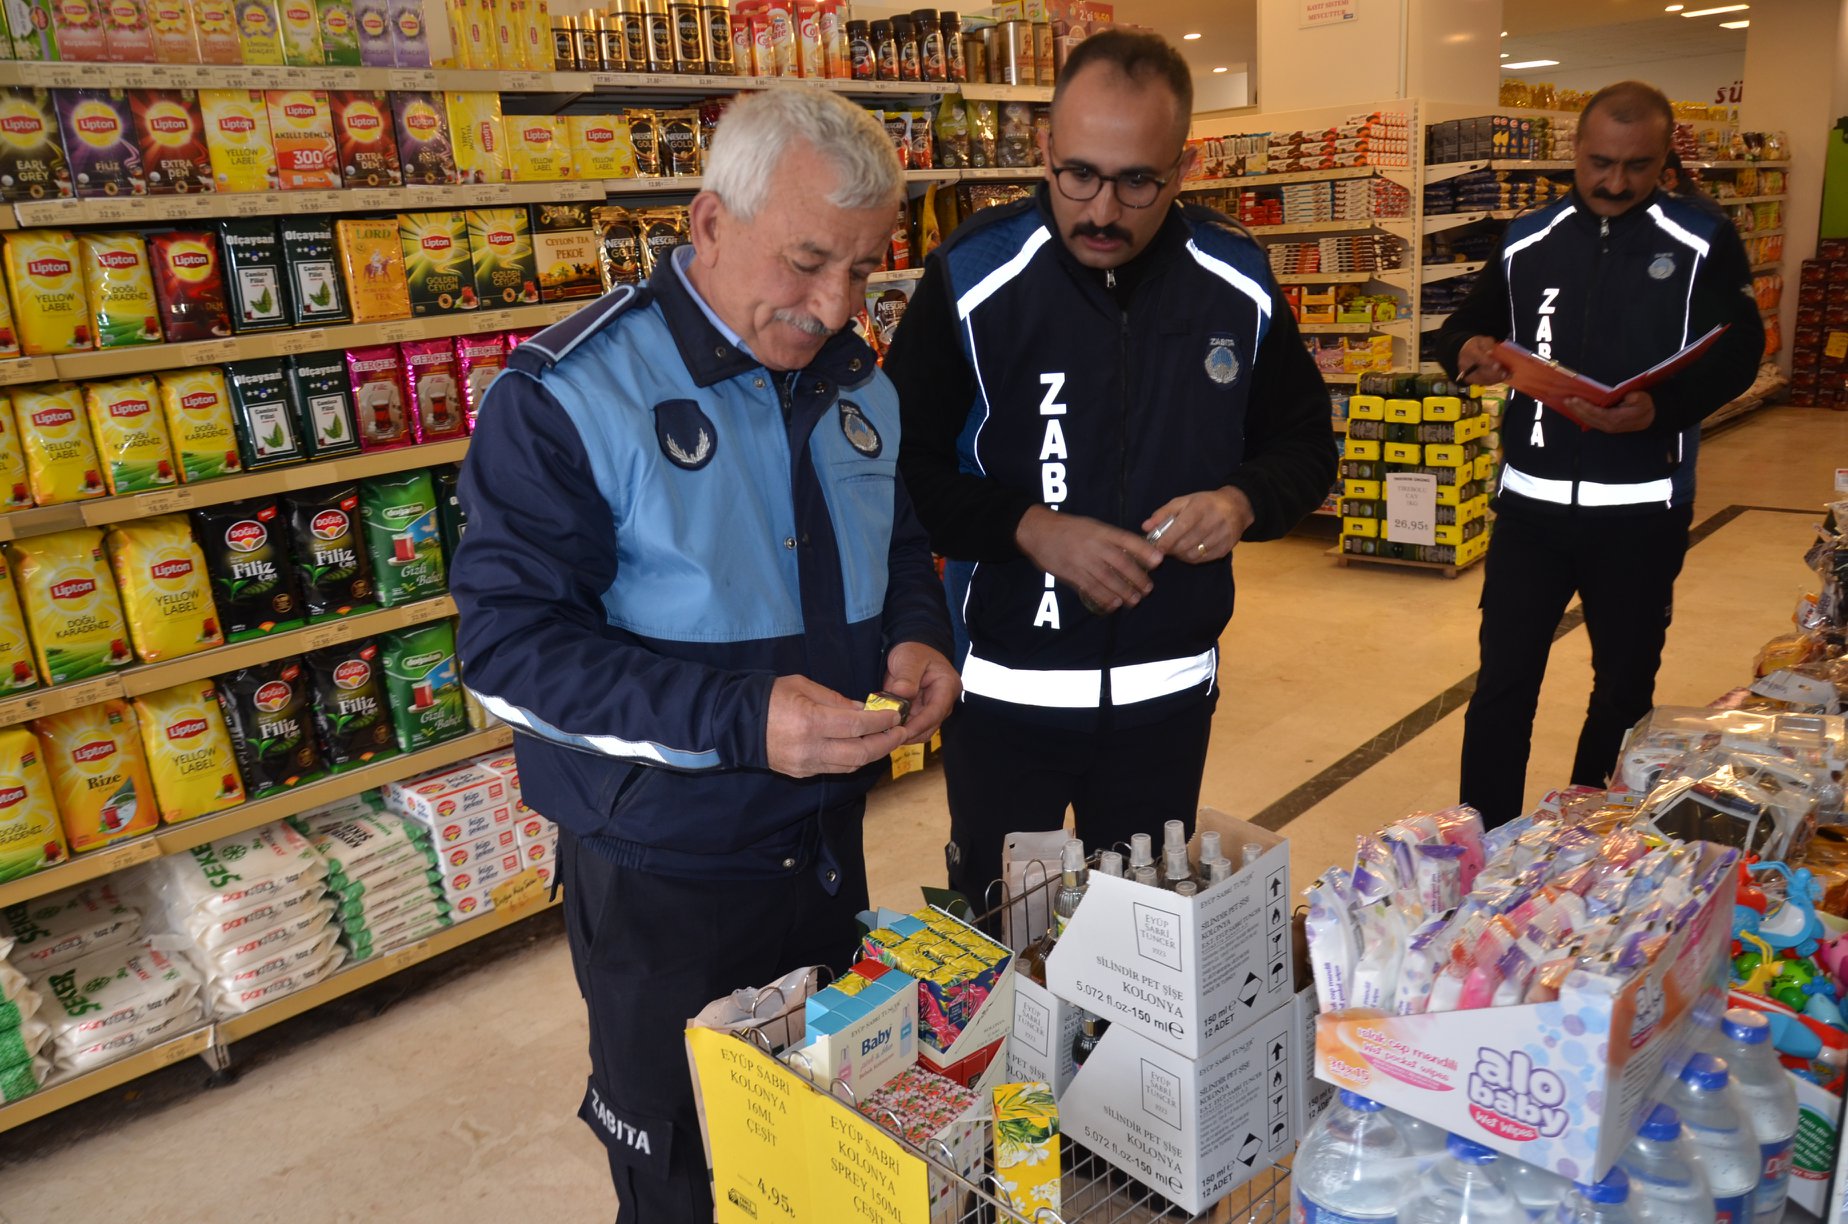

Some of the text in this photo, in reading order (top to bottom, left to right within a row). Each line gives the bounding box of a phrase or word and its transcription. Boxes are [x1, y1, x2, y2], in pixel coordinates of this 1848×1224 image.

[286, 105, 314, 117] Lipton
[4, 117, 41, 130] Lipton
[80, 117, 116, 130] Lipton
[153, 117, 187, 130] Lipton
[221, 117, 253, 131] Lipton
[350, 115, 378, 128] Lipton
[409, 116, 433, 127] Lipton
[526, 130, 551, 142] Lipton
[587, 130, 612, 141] Lipton
[671, 140, 693, 148] GOLD
[226, 148, 259, 158] YELLOW
[293, 150, 324, 165] 300
[356, 152, 384, 161] EXTRA
[592, 156, 615, 164] YELLOW
[16, 160, 47, 173] EARL
[160, 160, 193, 169] EXTRA
[230, 156, 257, 165] LABEL
[361, 160, 383, 169] DEM
[530, 157, 554, 165] YELLOW
[595, 163, 614, 171] LABEL
[168, 168, 190, 178] DEM
[534, 164, 552, 172] LABEL
[18, 171, 49, 182] GREY
[226, 234, 275, 246] Ofçaysan
[285, 229, 331, 241] Ofçaysan
[355, 228, 391, 240] LORD
[490, 233, 513, 243] Lipton
[573, 236, 590, 244] TEA
[424, 237, 450, 248] Lipton
[100, 253, 136, 266] Lipton
[175, 254, 208, 265] Lipton
[556, 248, 585, 259] PEKOE
[31, 261, 69, 273] Lipton
[426, 276, 459, 286] GOLDEN
[491, 270, 521, 280] GOLDEN
[493, 277, 521, 287] CEYLON
[427, 283, 459, 293] CEYLON
[35, 293, 75, 303] YELLOW
[41, 303, 73, 312] LABEL
[351, 358, 397, 372] GERÇEK
[410, 352, 454, 366] GERÇEK
[299, 364, 343, 377] Ofçaysan
[235, 371, 283, 386] Ofçaysan
[183, 393, 216, 406] Lipton
[111, 402, 148, 416] Lipton
[36, 411, 72, 424] Lipton
[194, 424, 218, 433] DOĞU
[123, 432, 149, 441] DOĞU
[42, 440, 82, 452] YELLOW
[50, 450, 80, 461] LABEL
[316, 516, 344, 527] DOĞUŞ
[230, 526, 260, 539] DOĞUŞ
[315, 549, 356, 567] Filiz
[154, 562, 192, 577] Lipton
[231, 560, 276, 580] Filiz
[401, 563, 428, 579] Gizli
[53, 582, 94, 597] Lipton
[155, 590, 200, 605] YELLOW
[163, 603, 199, 617] LABEL
[66, 615, 97, 628] DOĞU
[338, 696, 378, 716] Filiz
[420, 708, 446, 725] Gizli
[169, 720, 207, 738] Lipton
[258, 718, 300, 740] Filiz
[75, 742, 115, 761] Lipton
[172, 746, 217, 766] YELLOW
[179, 758, 216, 776] LABEL
[87, 772, 123, 792] Rize
[1144, 914, 1170, 928] EYÜP
[1144, 923, 1171, 939] SABRİ
[1140, 930, 1176, 950] TUNCER
[1096, 955, 1184, 1002] SİLİNDİR PET ŞİŞE
[1076, 980, 1104, 1002] 5.072
[1122, 982, 1184, 1019] KOLONYA
[1024, 1002, 1041, 1017] EYÜP
[1018, 1014, 1044, 1036] TUNCER
[1204, 1013, 1217, 1027] 150
[1204, 1013, 1235, 1039] 12 ADET
[861, 1026, 892, 1057] Baby
[721, 1048, 790, 1096] EYÜP SABRİ
[1012, 1053, 1046, 1080] PET ŞİŞE
[1150, 1071, 1176, 1086] EYÜP
[1475, 1046, 1567, 1107] alo
[730, 1070, 787, 1115] KOLONYA
[1150, 1079, 1175, 1098] SABRİ
[1145, 1085, 1177, 1109] TUNCER
[1468, 1072, 1569, 1138] baby
[747, 1099, 775, 1127] 16ML
[591, 1087, 652, 1156] ZABITA
[746, 1118, 778, 1147] ÇEŞİT
[1084, 1125, 1112, 1148] 5.072
[1104, 1105, 1183, 1159] SİLİNDİR PET ŞİŞE
[1499, 1121, 1537, 1141] Wipes
[831, 1115, 900, 1176] EYÜP SABRİ
[1126, 1133, 1183, 1175] KOLONYA
[831, 1158, 868, 1191] SPREY
[838, 1140, 896, 1196] KOLONYA
[1201, 1172, 1215, 1188] 150
[1201, 1172, 1233, 1199] 12 ADET
